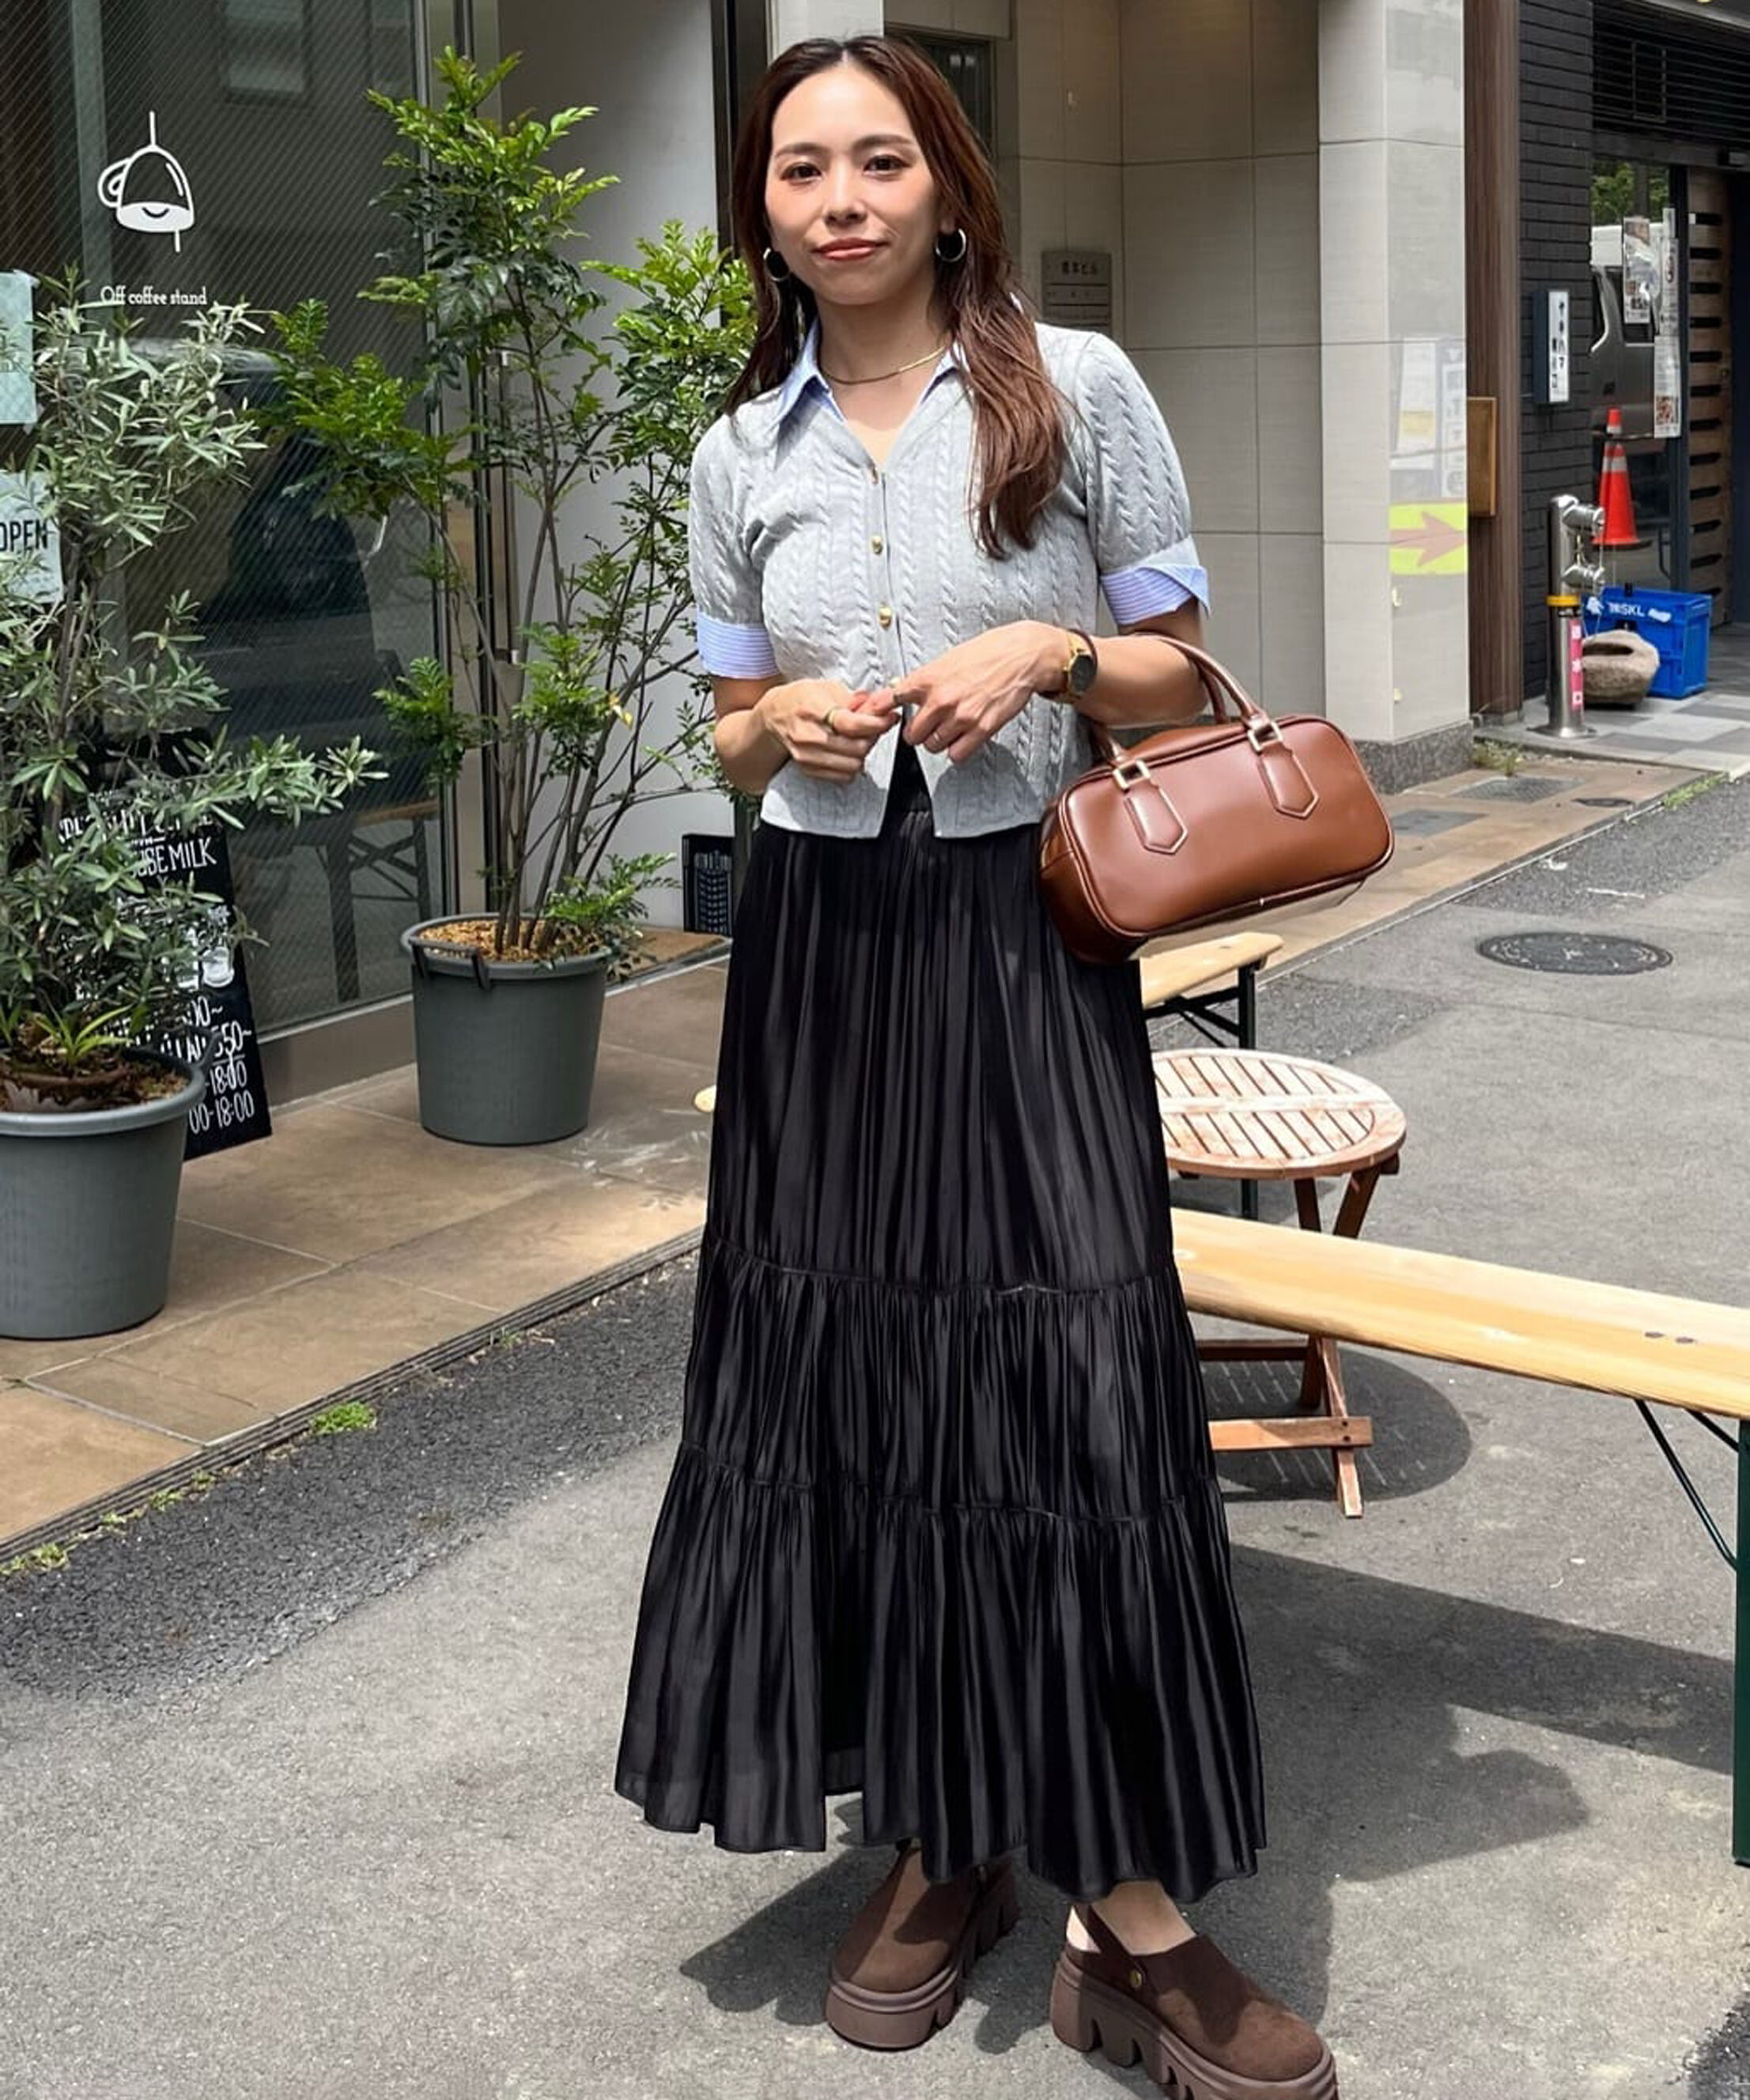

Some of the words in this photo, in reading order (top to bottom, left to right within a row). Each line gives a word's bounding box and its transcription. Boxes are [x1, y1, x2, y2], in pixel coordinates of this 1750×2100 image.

[100, 285, 126, 304] Off
[128, 285, 167, 305] coffee
[170, 286, 207, 305] stand
[168, 837, 217, 871] MILK
